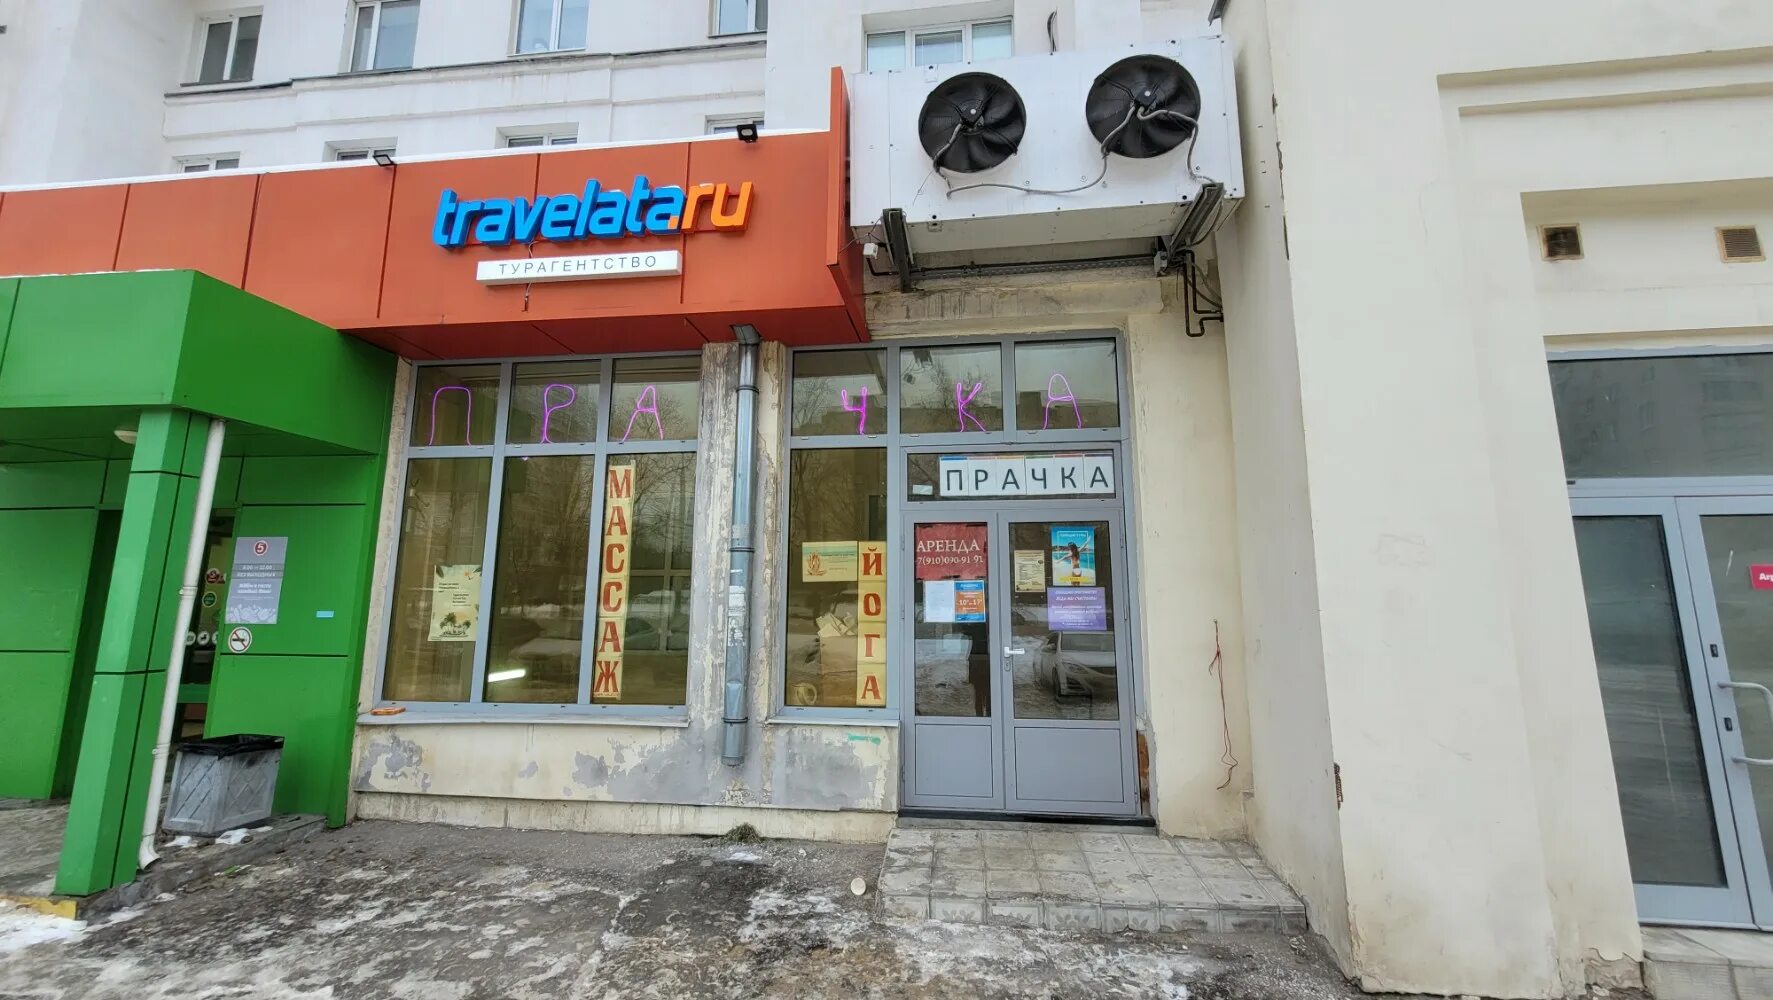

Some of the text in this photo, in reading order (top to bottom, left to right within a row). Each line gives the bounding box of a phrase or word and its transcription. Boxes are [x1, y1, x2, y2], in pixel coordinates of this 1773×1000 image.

[432, 175, 754, 248] travelata.ru
[498, 255, 658, 275] ТУРАГЕНТСТВО
[945, 465, 1110, 491] ПРАЧКА
[916, 539, 980, 554] АРЕНДА
[594, 467, 632, 694] МАССАЖ
[861, 546, 883, 699] ЙОГА
